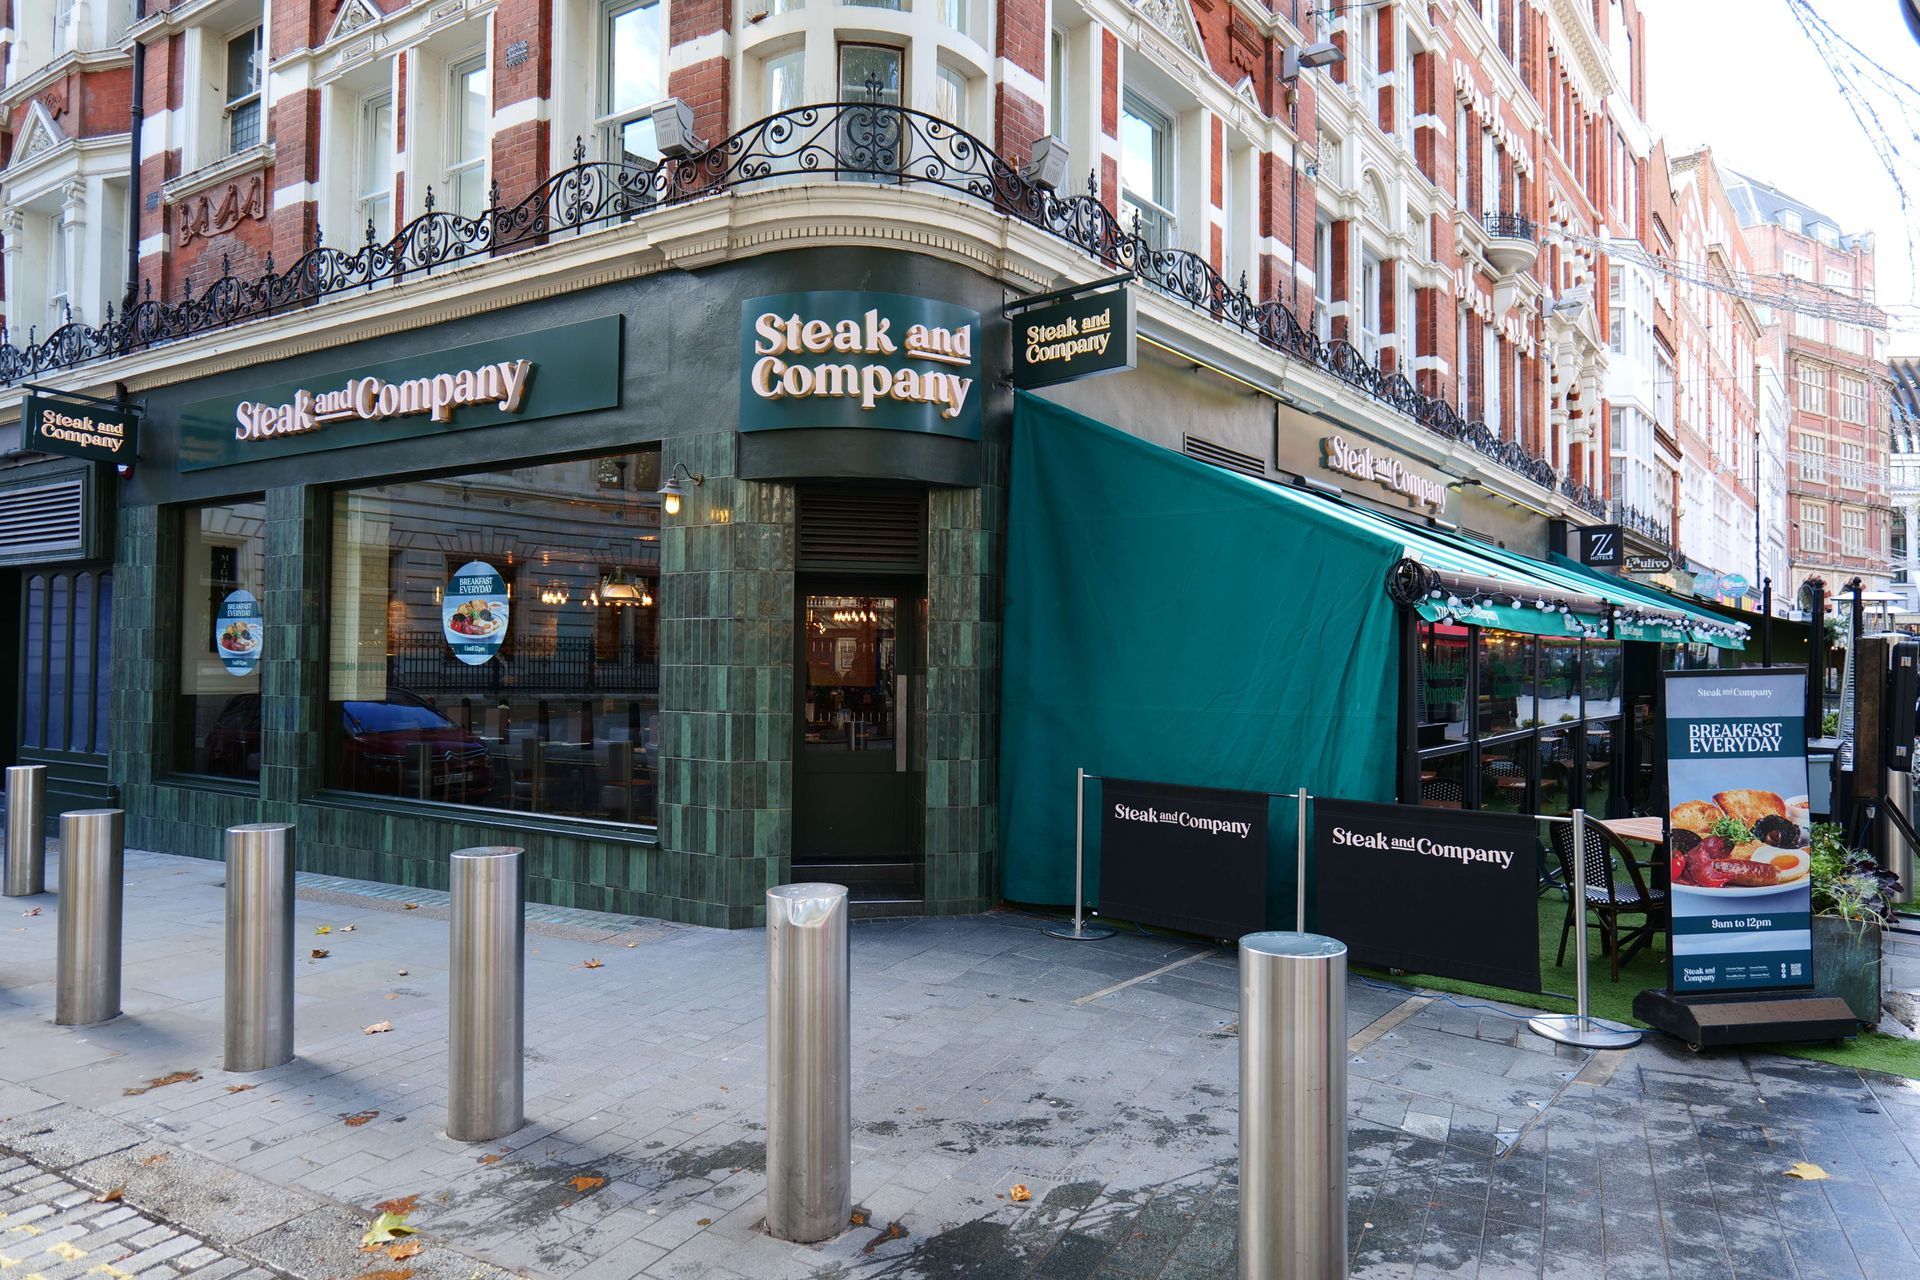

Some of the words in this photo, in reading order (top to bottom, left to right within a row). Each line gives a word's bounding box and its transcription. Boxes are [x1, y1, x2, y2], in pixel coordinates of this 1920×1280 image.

[755, 308, 897, 356] Steak
[904, 324, 971, 364] and
[1026, 316, 1079, 345] Steak
[1081, 308, 1110, 333] and
[1025, 332, 1111, 364] Company
[751, 356, 973, 418] Company
[236, 389, 314, 440] Steak
[315, 379, 354, 421] and
[355, 359, 532, 423] Company
[43, 409, 95, 432] Steak
[97, 422, 124, 437] and
[41, 423, 124, 452] Company
[1330, 435, 1375, 480] Steak
[1375, 457, 1393, 482] and
[1392, 460, 1447, 514] Company
[1591, 533, 1614, 556] Z
[459, 577, 493, 586] BREAKFAST
[460, 585, 493, 594] EVERYDAY
[227, 602, 252, 610] BREAKFAST
[227, 609, 252, 617] EVERYDAY
[1698, 688, 1721, 697] Steak
[1722, 688, 1733, 696] and
[1733, 688, 1773, 699] Company
[1689, 723, 1782, 738] BREAKFAST
[1690, 737, 1782, 753] EVERYDAY
[1115, 803, 1158, 823] Steak
[1160, 811, 1178, 823] and
[1179, 812, 1251, 839] Company
[1332, 827, 1389, 850] Steak
[1391, 837, 1415, 851] and
[1417, 838, 1514, 869] Company
[1711, 919, 1733, 928] 9am
[1734, 920, 1745, 928] to
[1746, 917, 1772, 929] 12pm
[1683, 967, 1704, 976] Steak
[1704, 966, 1716, 975] and
[1683, 974, 1716, 983] Company
